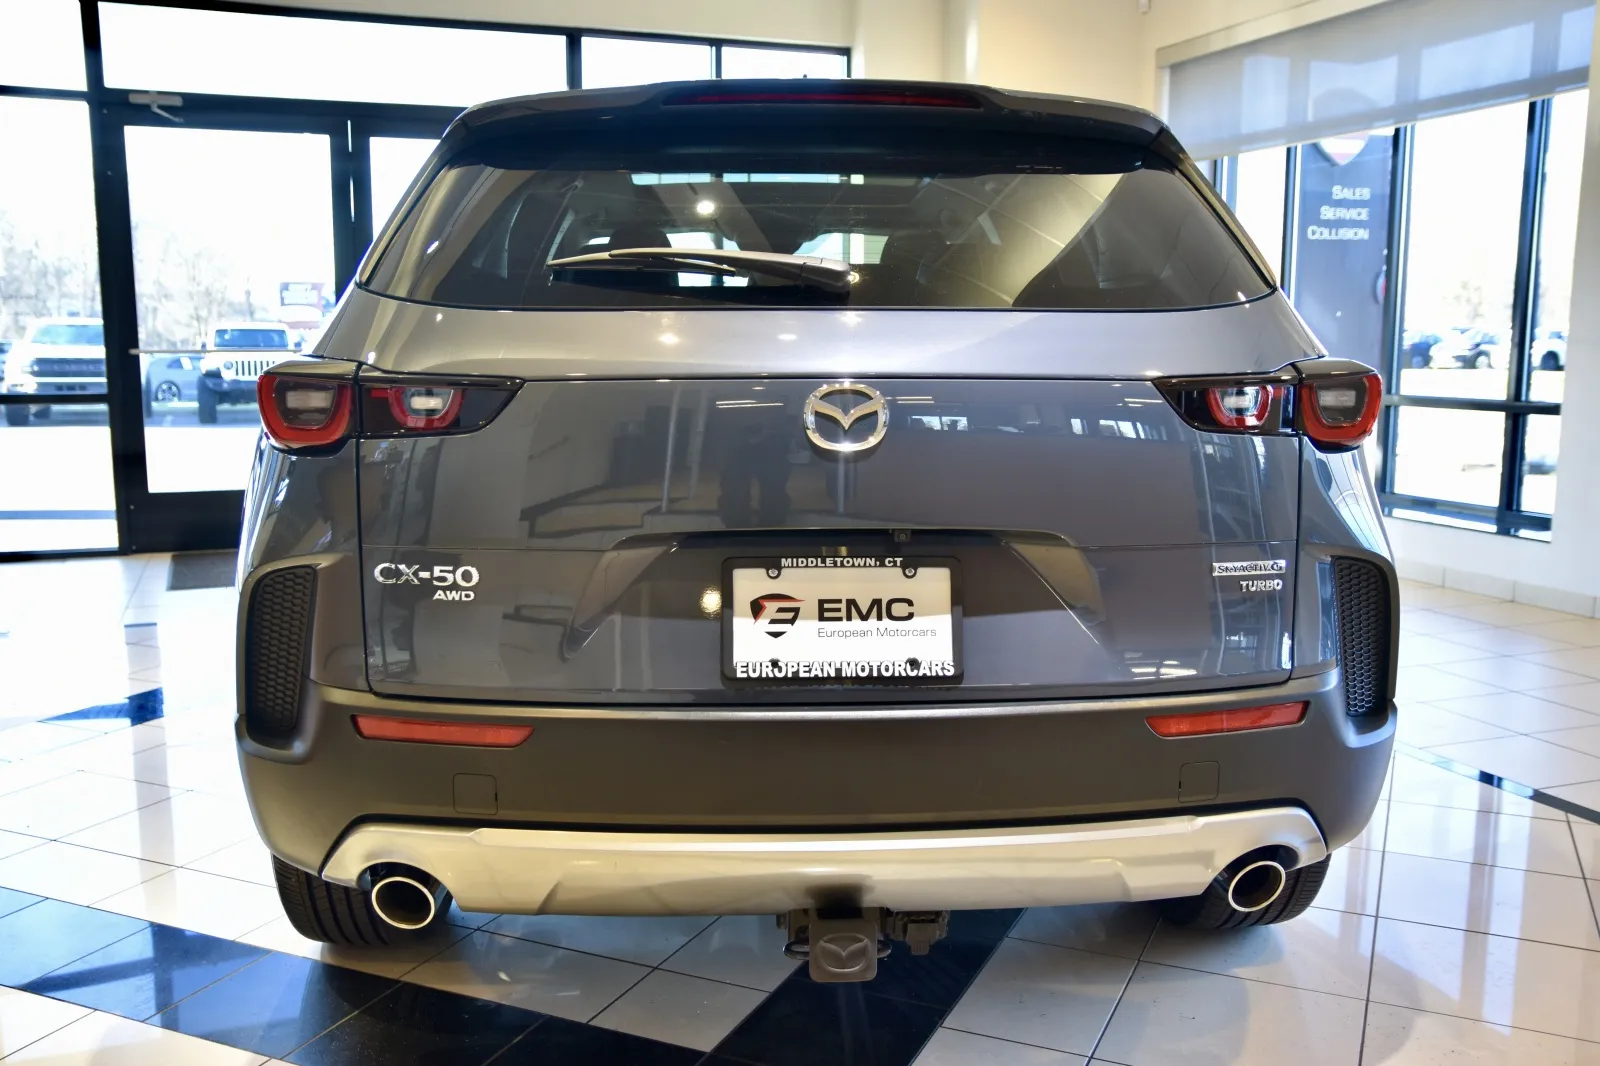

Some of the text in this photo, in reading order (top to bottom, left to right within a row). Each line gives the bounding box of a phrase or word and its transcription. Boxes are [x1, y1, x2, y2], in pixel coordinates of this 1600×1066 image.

[781, 557, 903, 567] MIDDLETOWN, CT
[373, 562, 480, 587] CX-50
[1239, 579, 1283, 592] TURBO
[432, 589, 475, 601] AWD
[817, 598, 915, 622] EMC
[817, 627, 937, 639] European Motorcars
[736, 660, 955, 678] EUROPEAN MOTORCARS
